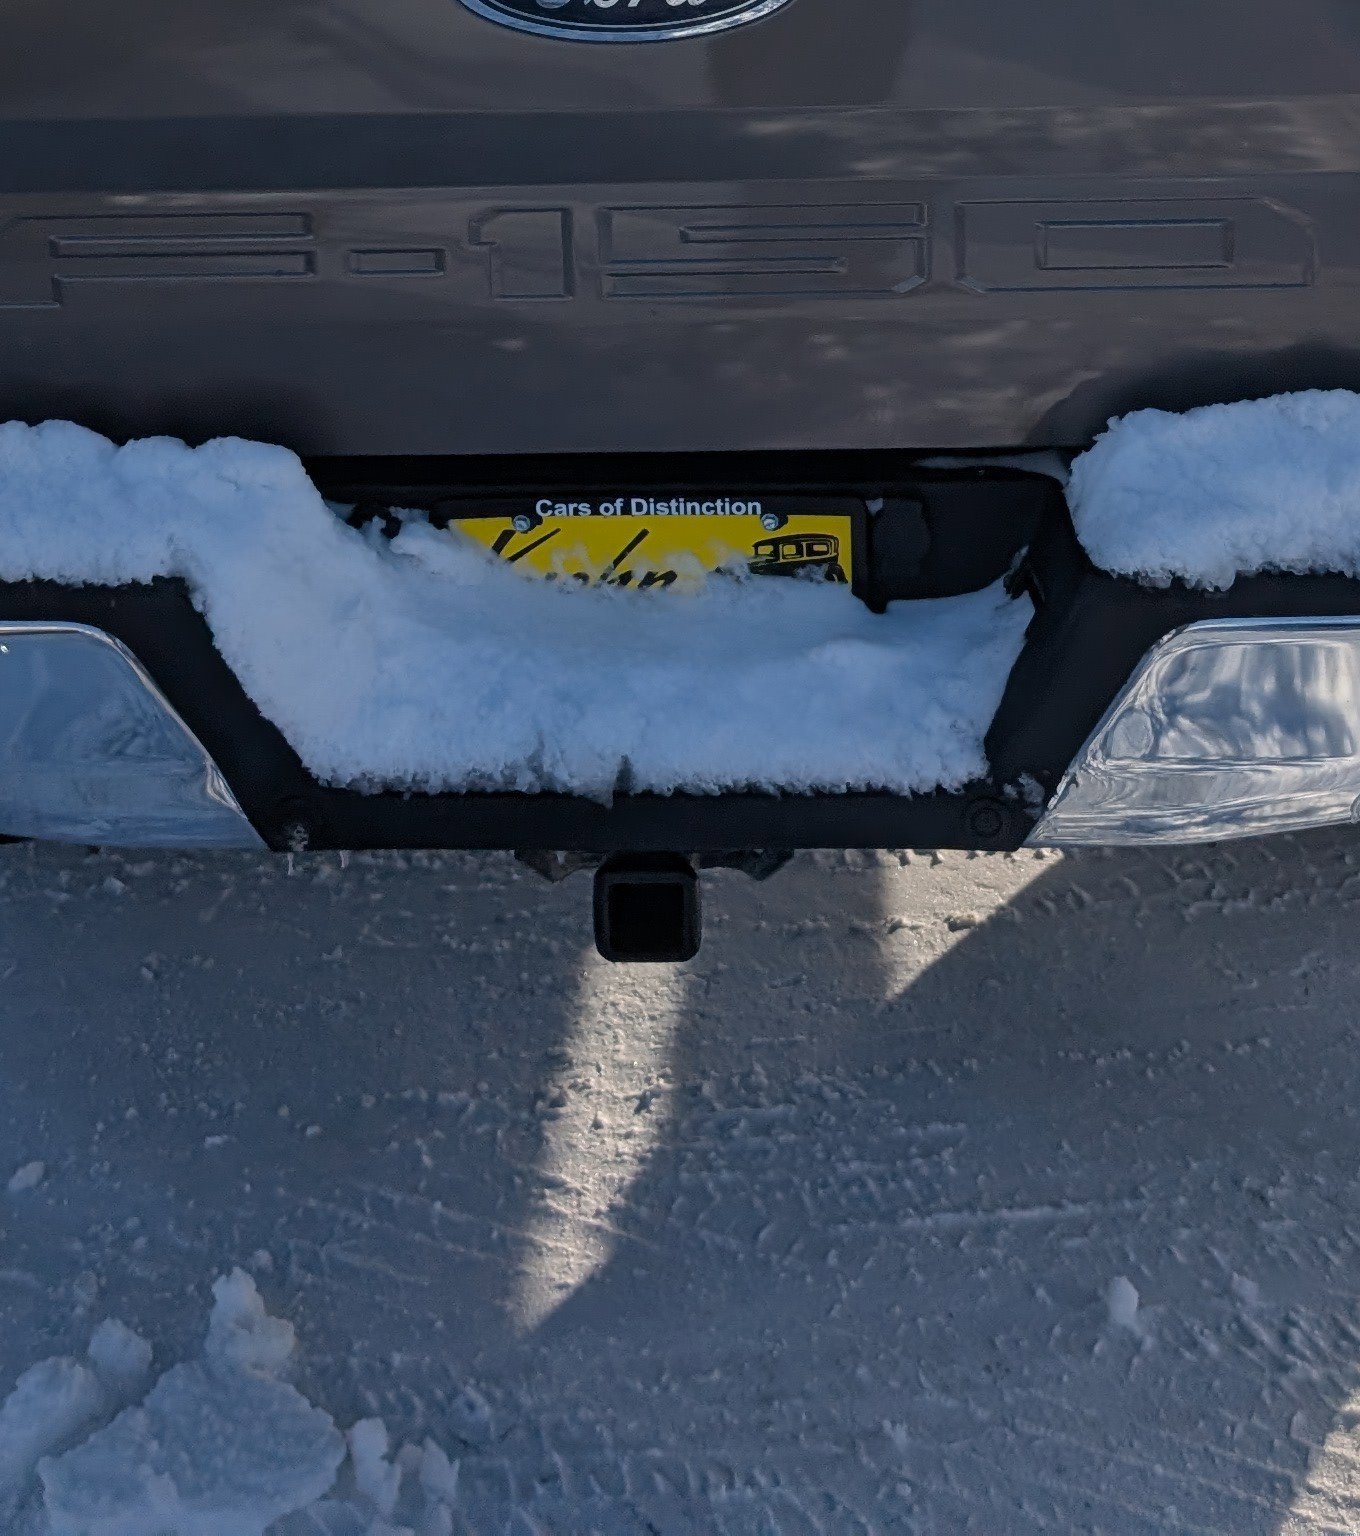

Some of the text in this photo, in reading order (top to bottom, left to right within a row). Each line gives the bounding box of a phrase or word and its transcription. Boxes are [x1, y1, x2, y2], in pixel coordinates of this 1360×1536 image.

[535, 497, 762, 516] Cars of Distinction
